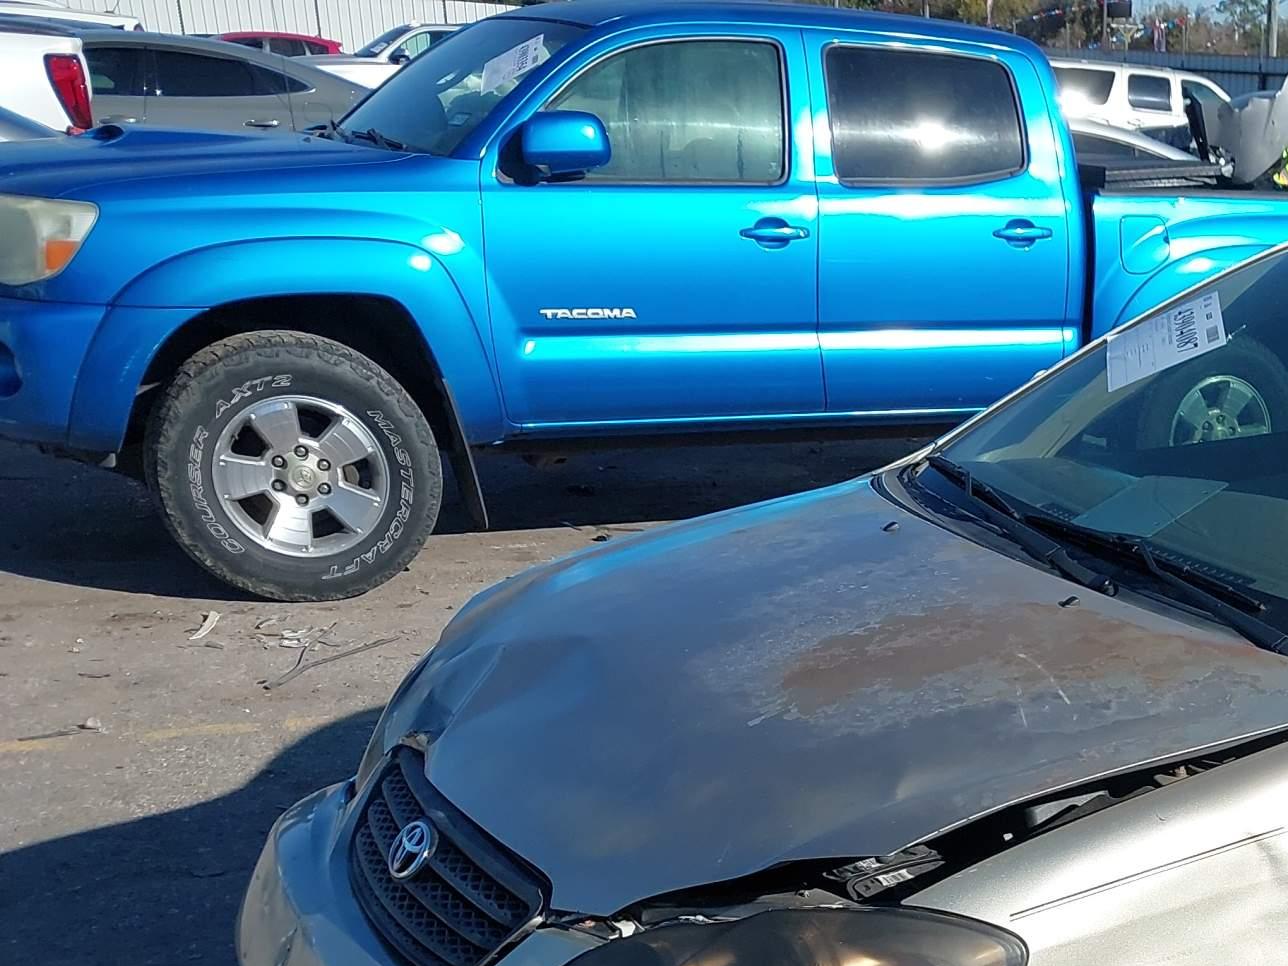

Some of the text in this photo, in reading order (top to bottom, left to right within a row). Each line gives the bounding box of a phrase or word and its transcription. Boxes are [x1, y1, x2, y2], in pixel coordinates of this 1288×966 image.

[540, 308, 637, 319] TACOMA
[1174, 308, 1198, 353] 43904087
[188, 374, 293, 554] COURSER AXT2
[321, 408, 415, 580] MASTERCRAFT
